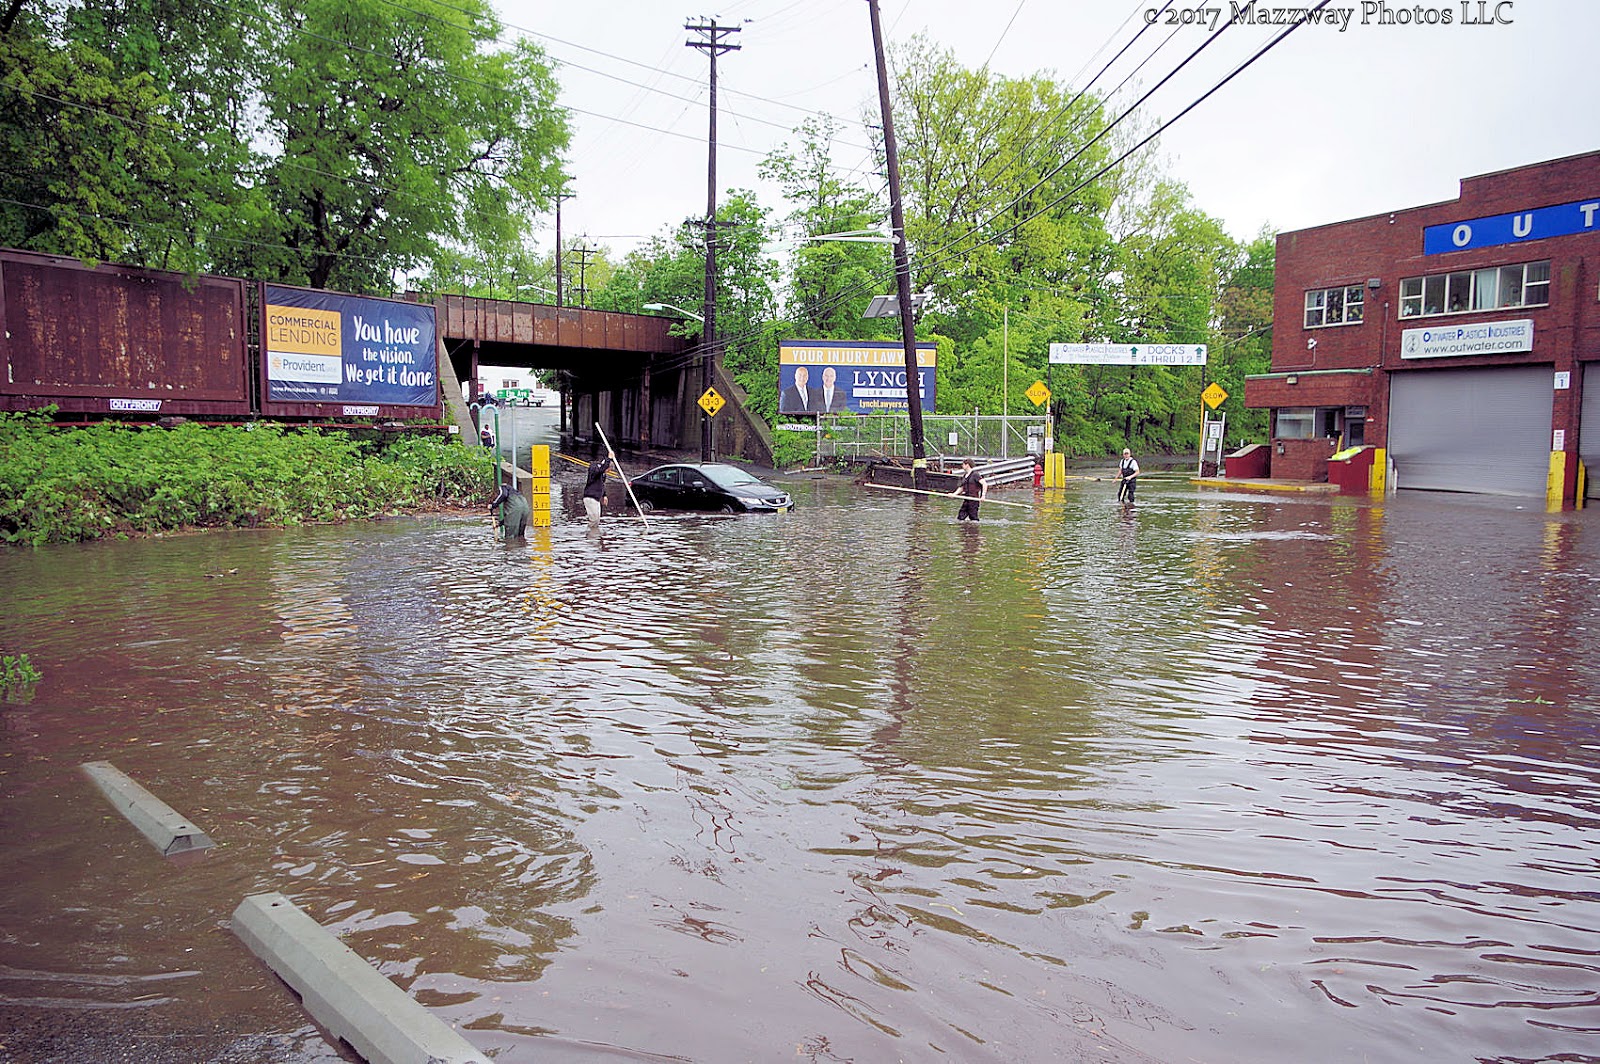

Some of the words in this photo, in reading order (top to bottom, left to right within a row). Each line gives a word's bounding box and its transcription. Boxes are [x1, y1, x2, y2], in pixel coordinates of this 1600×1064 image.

[270, 315, 337, 330] COMMERCIAL
[353, 315, 382, 343] You
[385, 319, 420, 345] have
[270, 328, 337, 346] LENDING
[1457, 328, 1487, 340] PLASTICS
[1488, 325, 1526, 338] INDUSTRIES
[1147, 345, 1185, 355] DOCKS
[1423, 339, 1523, 354] www.outwater.com
[363, 347, 378, 362] the
[380, 346, 415, 365] vision.
[792, 350, 823, 362] YOUR
[827, 350, 869, 363] INJURY
[873, 351, 926, 365] LAWYS
[1151, 355, 1176, 364] THRU
[1181, 355, 1193, 364] 12
[282, 358, 325, 372] Provident
[345, 363, 364, 383] We
[365, 364, 385, 386] get
[387, 365, 397, 385] it
[400, 365, 434, 387] done.
[1204, 392, 1223, 400] SLOW
[111, 400, 158, 410] OUTFRONT
[859, 399, 909, 409] LynchLawyers.co
